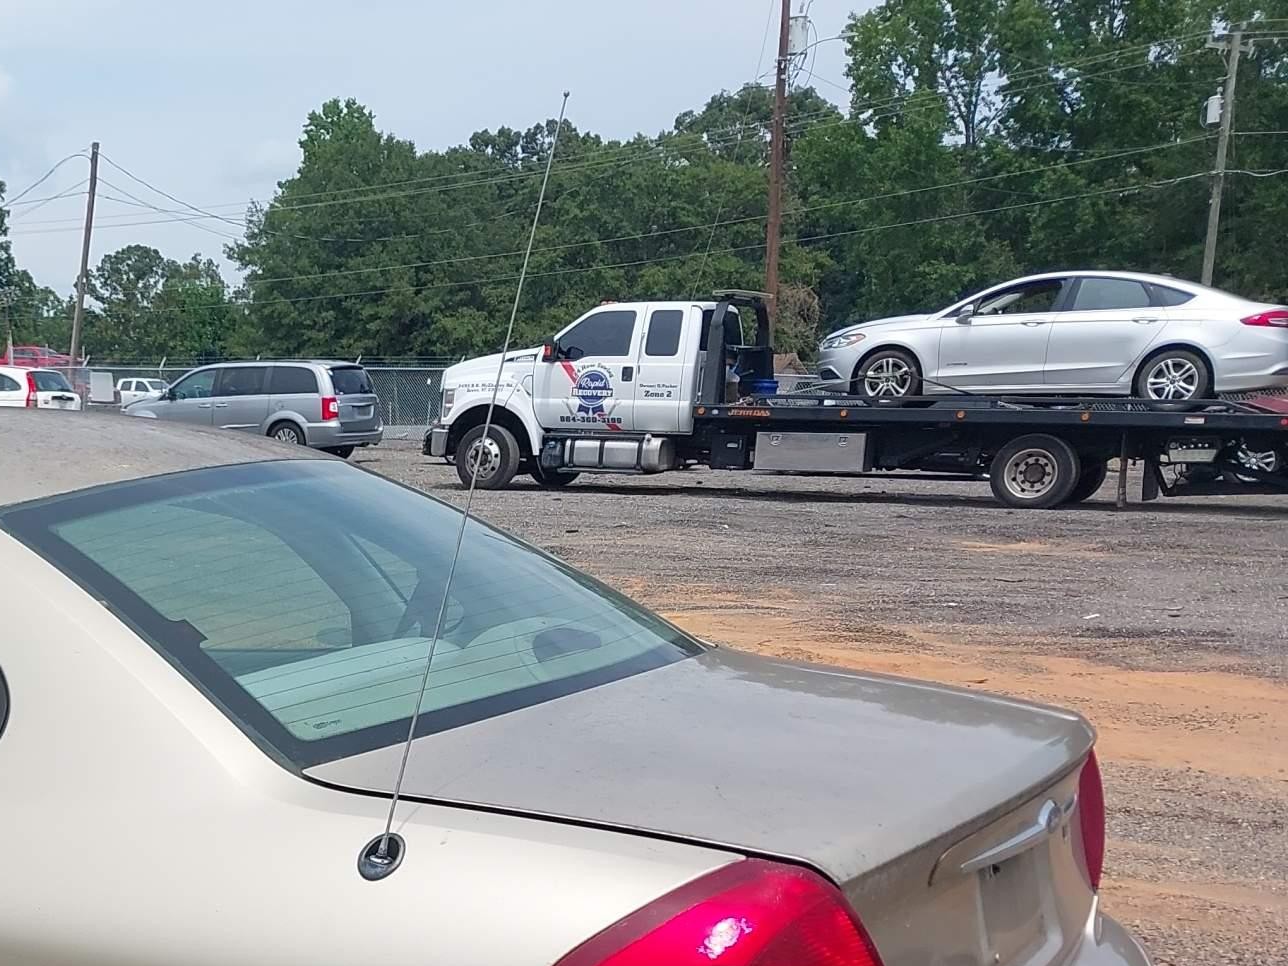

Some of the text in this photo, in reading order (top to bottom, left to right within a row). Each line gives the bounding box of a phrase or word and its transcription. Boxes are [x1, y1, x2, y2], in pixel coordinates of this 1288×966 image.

[580, 377, 607, 389] Rapid
[572, 388, 613, 397] RECOVERY
[643, 390, 672, 398] Zone 2
